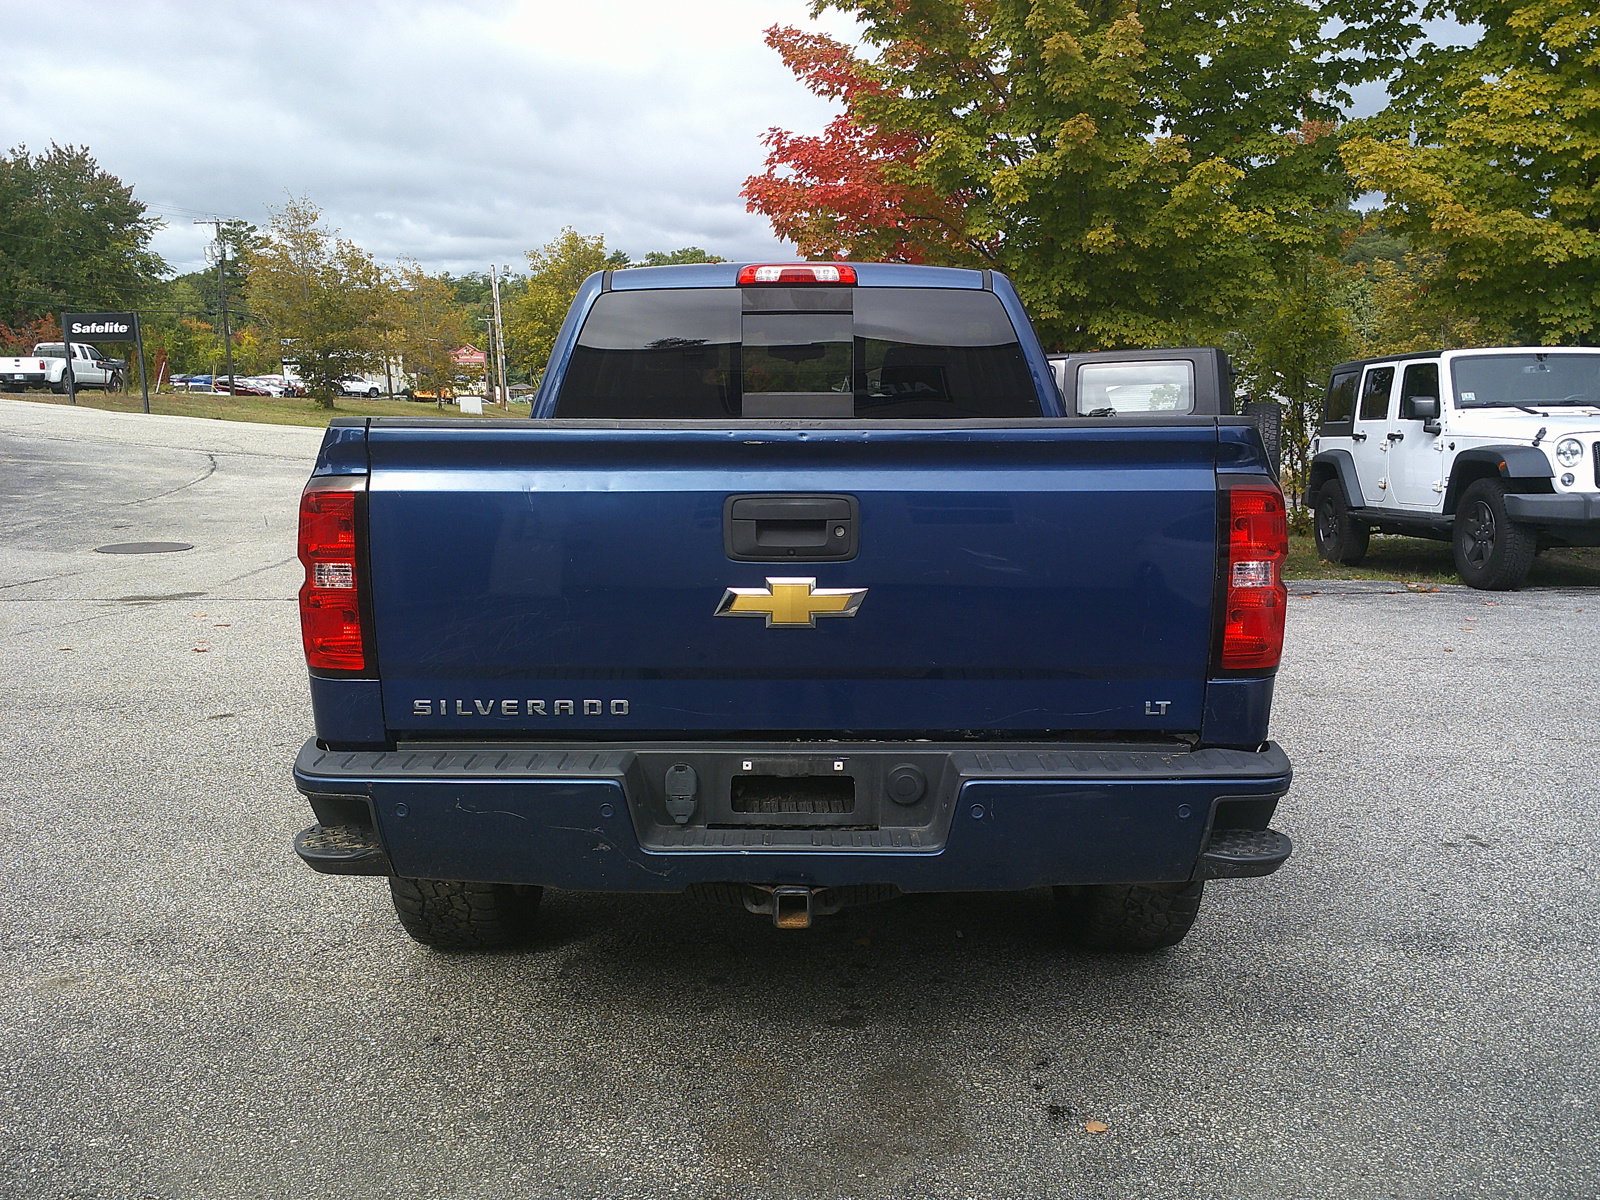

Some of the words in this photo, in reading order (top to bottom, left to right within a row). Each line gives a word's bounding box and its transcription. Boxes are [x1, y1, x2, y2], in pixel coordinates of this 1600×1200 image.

[71, 322, 128, 334] Safelite
[413, 699, 630, 716] SILVERADO
[1145, 701, 1171, 715] LT
